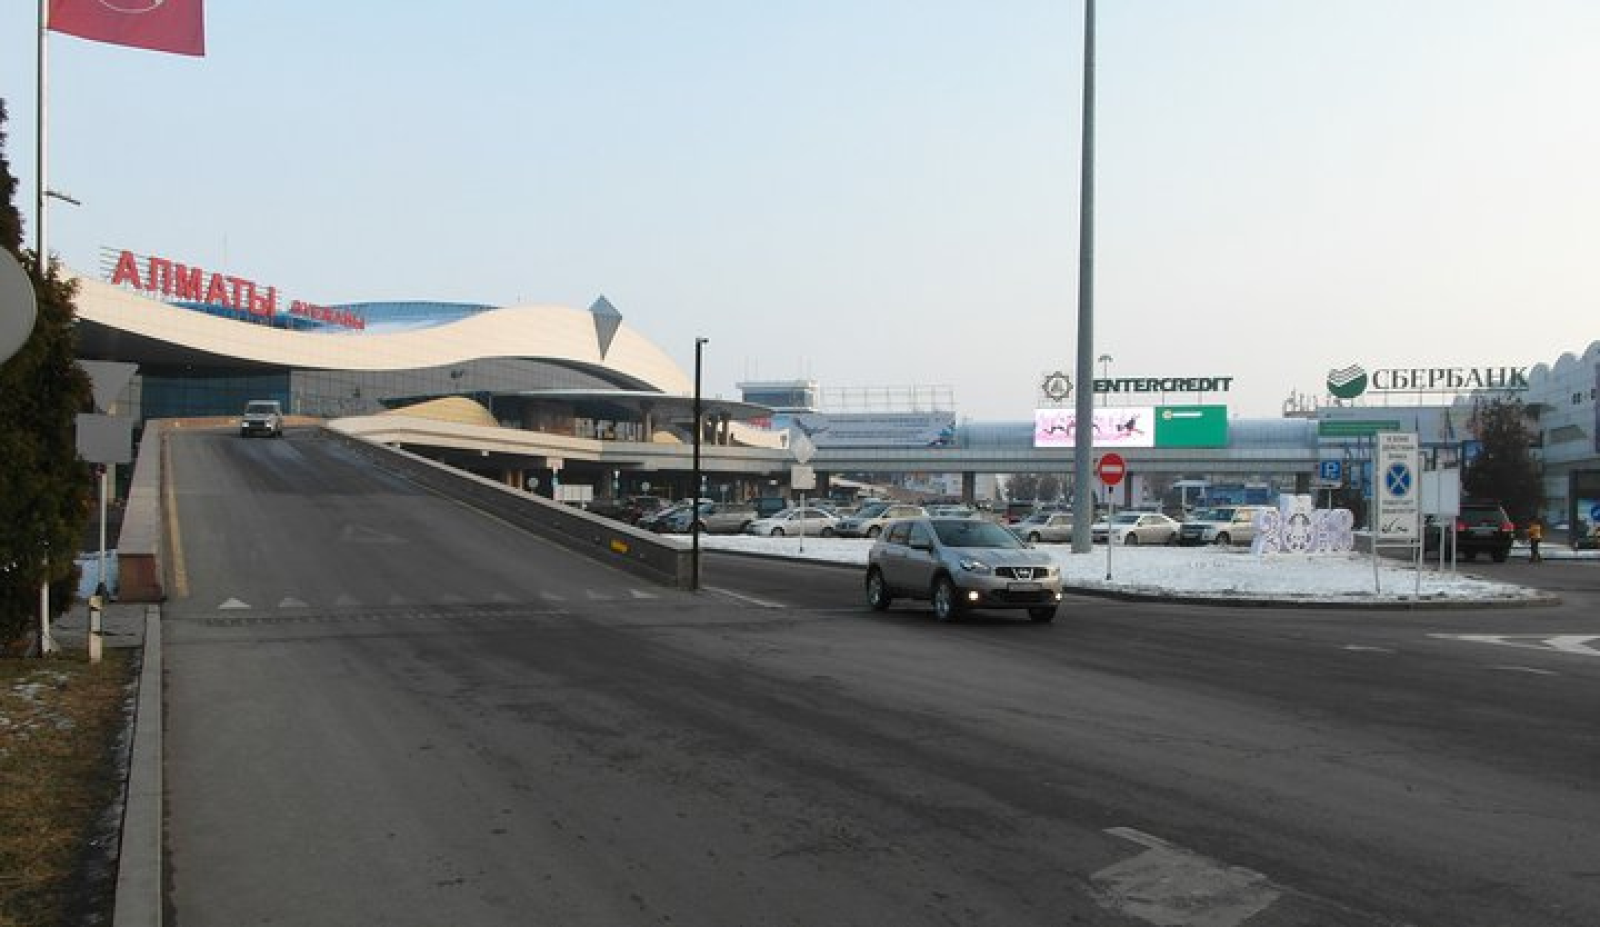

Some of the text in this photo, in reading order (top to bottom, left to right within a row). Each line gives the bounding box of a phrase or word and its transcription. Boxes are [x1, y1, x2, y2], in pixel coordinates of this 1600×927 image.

[111, 250, 276, 317] АЛМАТЫ
[1093, 377, 1234, 392] ENTERCREDIT
[1372, 366, 1529, 390] СБЕРБАНК
